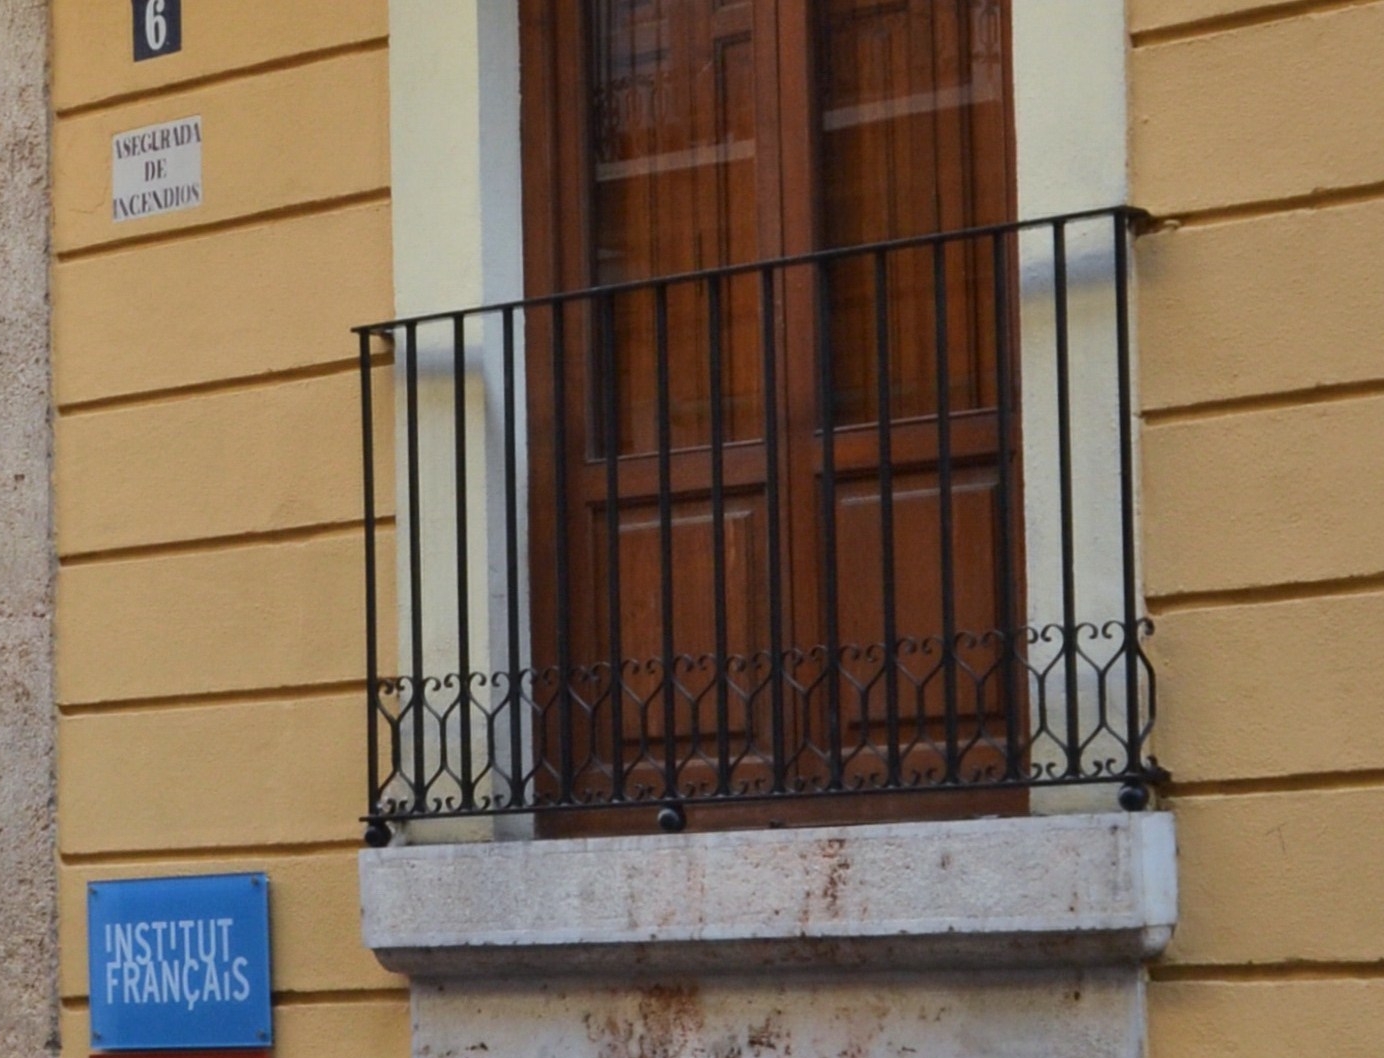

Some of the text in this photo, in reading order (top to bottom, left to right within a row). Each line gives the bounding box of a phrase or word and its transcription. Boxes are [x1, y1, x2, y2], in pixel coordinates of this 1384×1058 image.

[145, 0, 167, 51] 6
[115, 122, 202, 160] ASEGURADA
[144, 158, 167, 182] DE
[113, 182, 200, 219] INCENDIOS
[105, 918, 233, 966] INSTITUT
[106, 956, 250, 1011] FRANÇAIS
